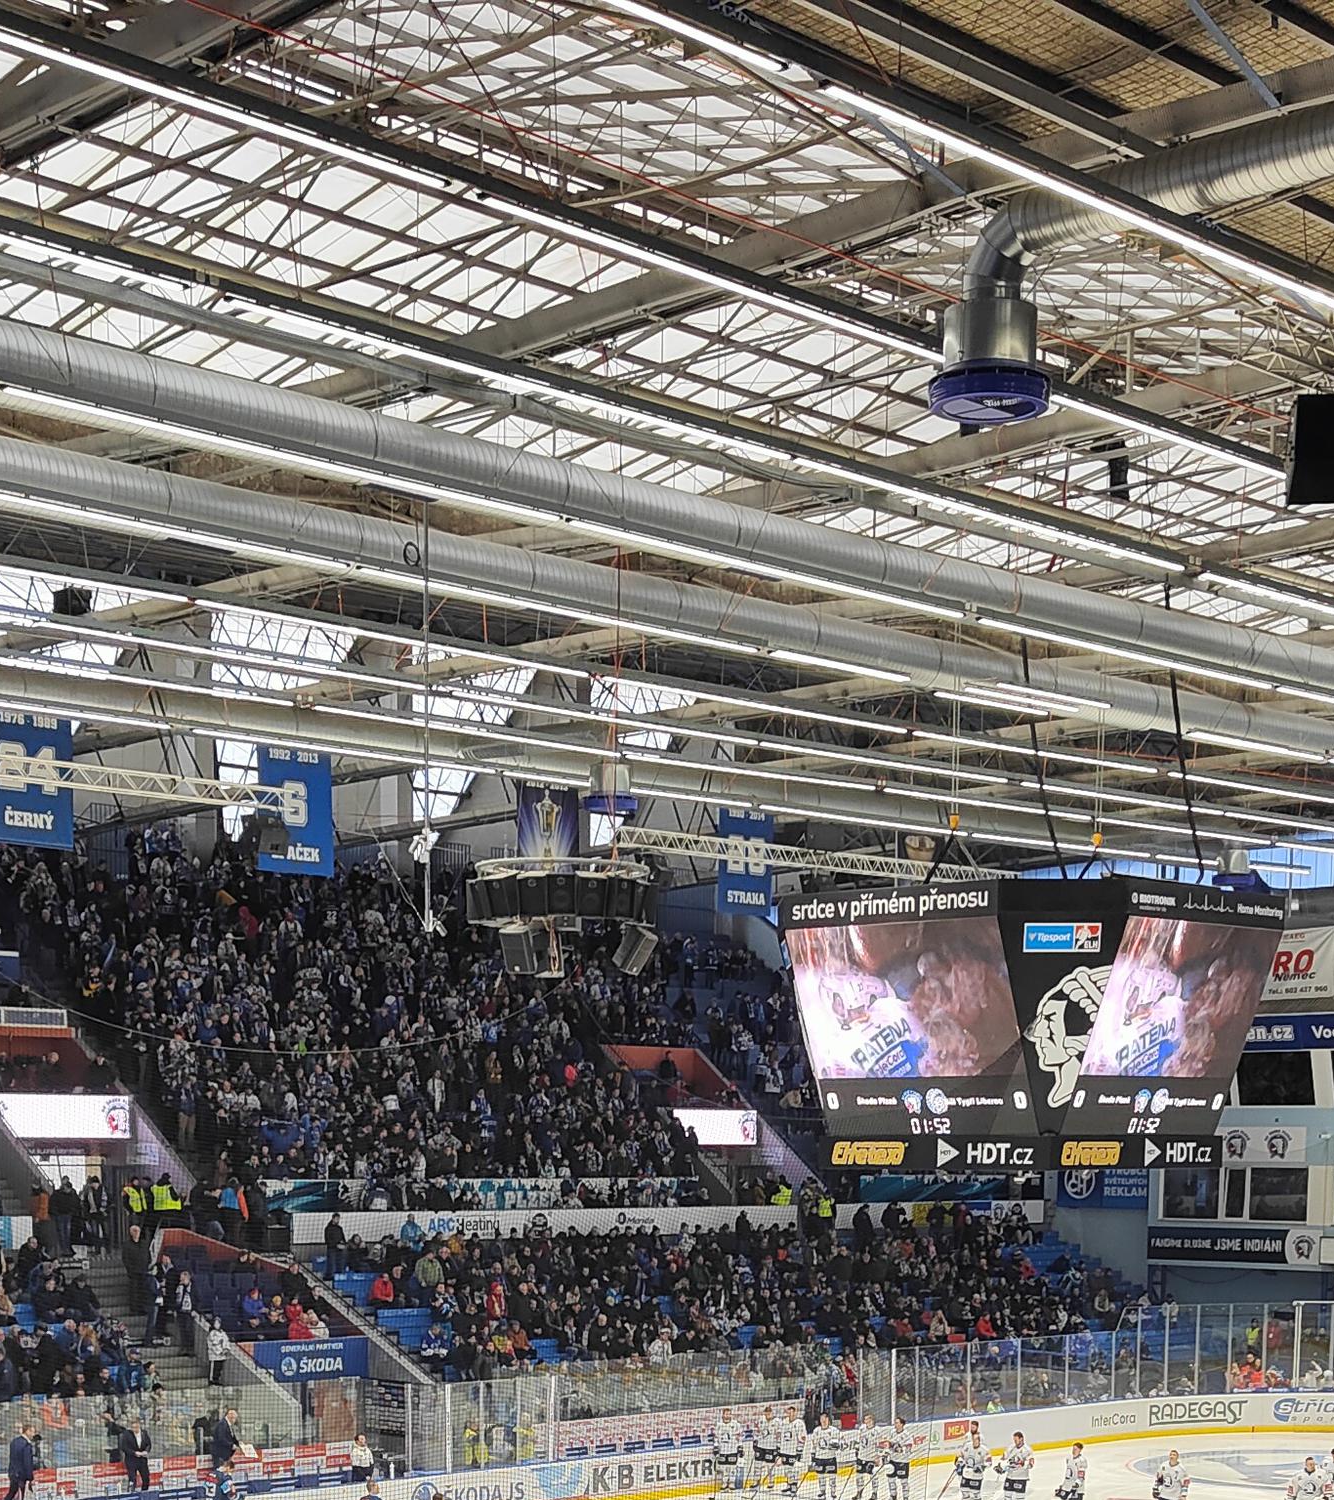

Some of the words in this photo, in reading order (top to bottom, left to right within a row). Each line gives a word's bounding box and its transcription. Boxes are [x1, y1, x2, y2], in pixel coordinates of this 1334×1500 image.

[32, 715, 58, 730] 1989
[268, 747, 292, 761] 1992
[297, 751, 319, 764] 2013
[4, 805, 55, 830] ČERNÝ
[727, 890, 765, 906] STRAKA
[792, 899, 835, 921] srdce
[838, 902, 848, 918] v
[850, 891, 915, 921] přímém
[918, 888, 988, 917] přenosu
[1254, 904, 1284, 920] Monitoring
[1037, 932, 1071, 944] Tipsport
[1084, 939, 1099, 949] ELH
[1271, 948, 1314, 976] RO
[826, 1092, 840, 1110] 0
[1012, 1091, 1028, 1109] 0
[1073, 1089, 1086, 1108] 0
[1211, 1093, 1224, 1110] 0
[910, 1117, 951, 1135] 01:52
[1127, 1117, 1161, 1134] 01:52
[966, 1143, 1034, 1165] HDT.cz
[1166, 1142, 1212, 1163] HDT.cz
[1214, 1239, 1242, 1251] JSME
[299, 1354, 344, 1374] ŠKODA
[1091, 1413, 1136, 1428] InterCora
[1149, 1400, 1248, 1426] RADEGAST
[948, 1425, 965, 1436] MEA
[505, 1482, 525, 1500] JS
